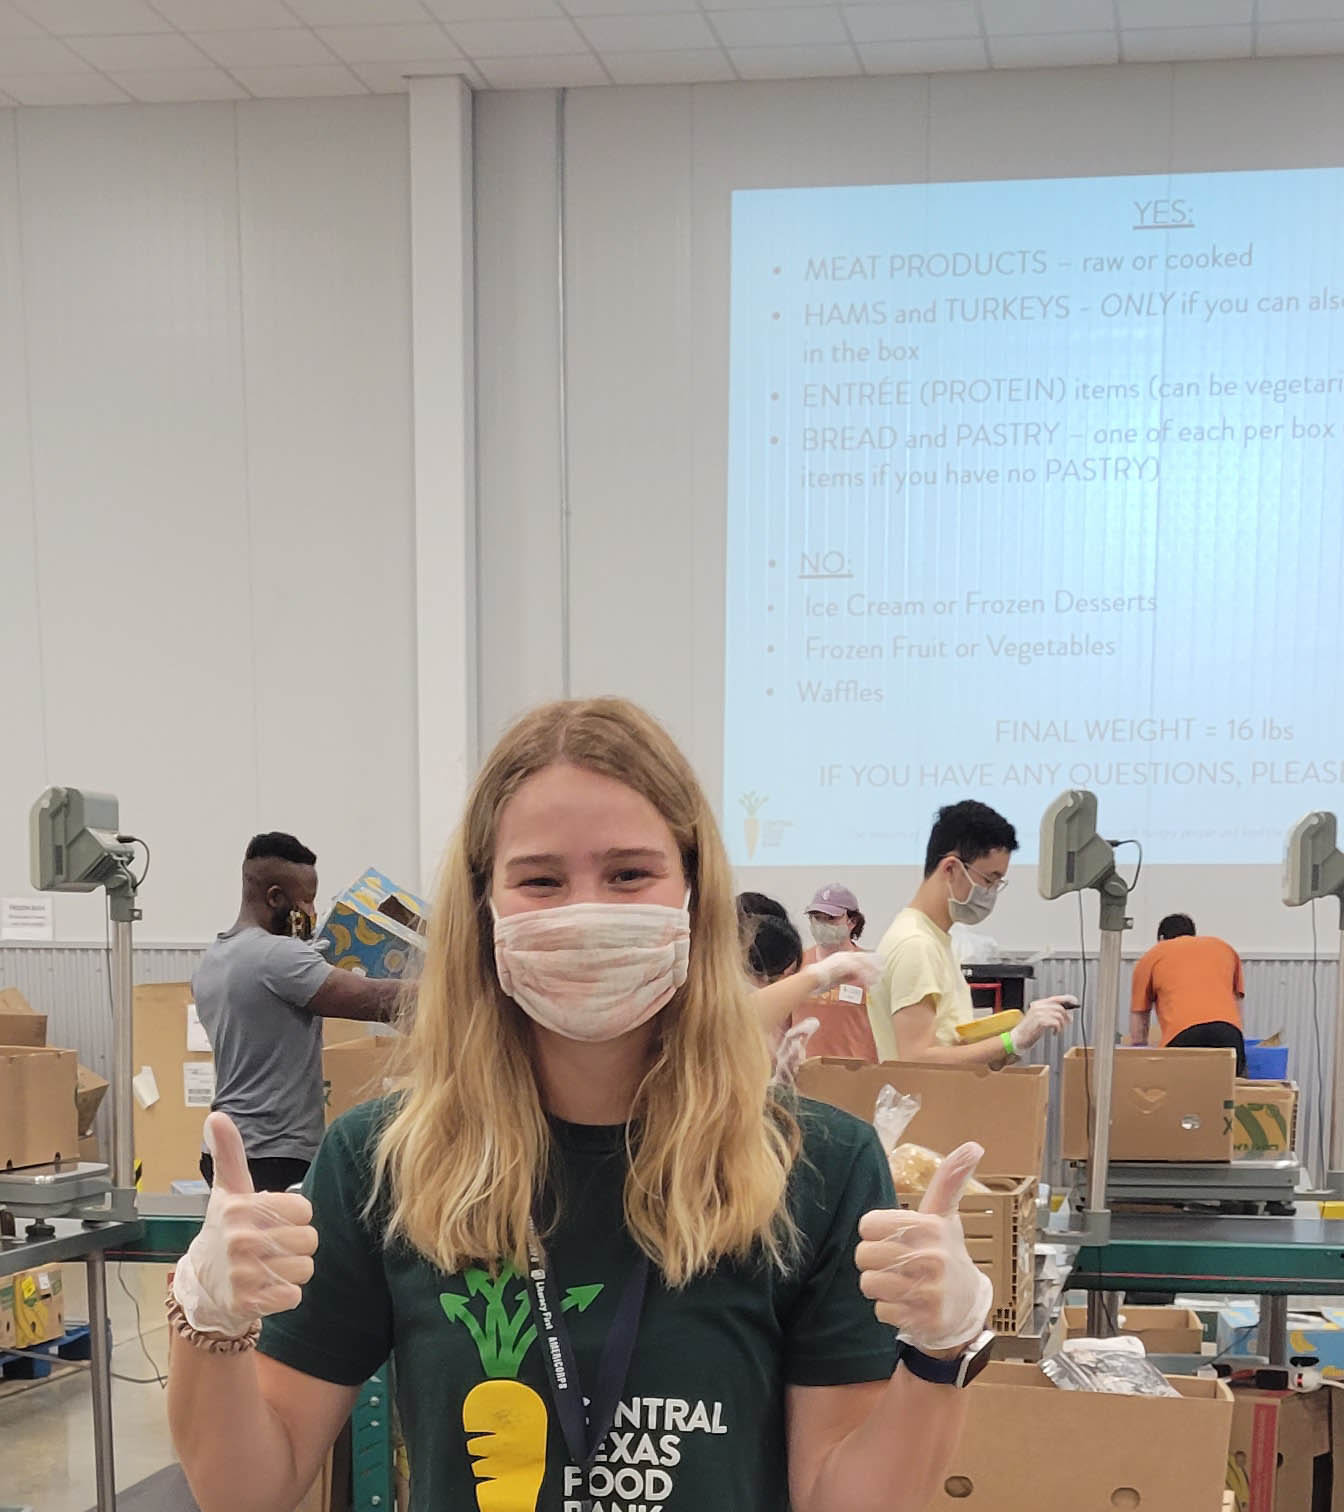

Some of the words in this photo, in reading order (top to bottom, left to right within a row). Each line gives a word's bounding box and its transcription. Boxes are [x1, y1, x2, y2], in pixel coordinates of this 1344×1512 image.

[1133, 199, 1195, 227] YES:
[805, 256, 881, 281] MEAT
[888, 251, 1048, 278] PRODUCTS
[1082, 255, 1124, 272] raw
[1132, 255, 1159, 271] or
[1165, 242, 1254, 269] cooked
[805, 302, 887, 326] HAMS
[895, 300, 937, 324] and
[945, 296, 1071, 322] TURKEYS
[1101, 293, 1176, 318] ONLY
[1181, 290, 1200, 315] if
[1205, 293, 1248, 322] you
[1257, 294, 1300, 313] can
[804, 342, 824, 364] in
[831, 340, 871, 362] the
[878, 339, 920, 362] box
[803, 376, 911, 408] ENTRÉE
[919, 375, 1067, 407] (PROTEIN)
[1074, 377, 1141, 401] items
[1149, 373, 1199, 401] (can
[1208, 373, 1238, 396] be
[802, 425, 898, 451] BREAD
[905, 424, 948, 449] and
[956, 422, 1061, 448] PASTRY
[1094, 426, 1138, 445] one
[1146, 417, 1173, 443] of
[1178, 416, 1235, 442] each
[1244, 420, 1285, 448] per
[1292, 415, 1335, 440] box
[801, 465, 865, 488] items
[872, 463, 890, 486] if
[895, 467, 937, 494] you
[945, 462, 999, 485] have
[1007, 466, 1037, 484] no
[1045, 456, 1160, 483] PASTRY)
[799, 551, 853, 576] NO:
[805, 594, 839, 617] Ice
[846, 592, 926, 616] Cream
[933, 599, 959, 616] or
[965, 590, 1045, 615] Frozen
[1055, 589, 1158, 614] Desserts
[805, 636, 883, 661] Frozen
[892, 634, 946, 659] Fruit
[955, 641, 981, 658] or
[985, 632, 1116, 665] Vegetables
[797, 679, 885, 703] Waffles
[994, 719, 1078, 744] FINAL
[1084, 717, 1196, 743] WEIGHT
[1226, 718, 1254, 742] 16
[1260, 718, 1295, 742] lbs
[818, 764, 842, 787] IF
[850, 763, 911, 788] YOU
[919, 762, 996, 787] HAVE
[1002, 762, 1064, 786] ANY
[1068, 761, 1243, 789] QUESTIONS,
[583, 1397, 728, 1435] NTRAL
[563, 1466, 674, 1501] FOOD
